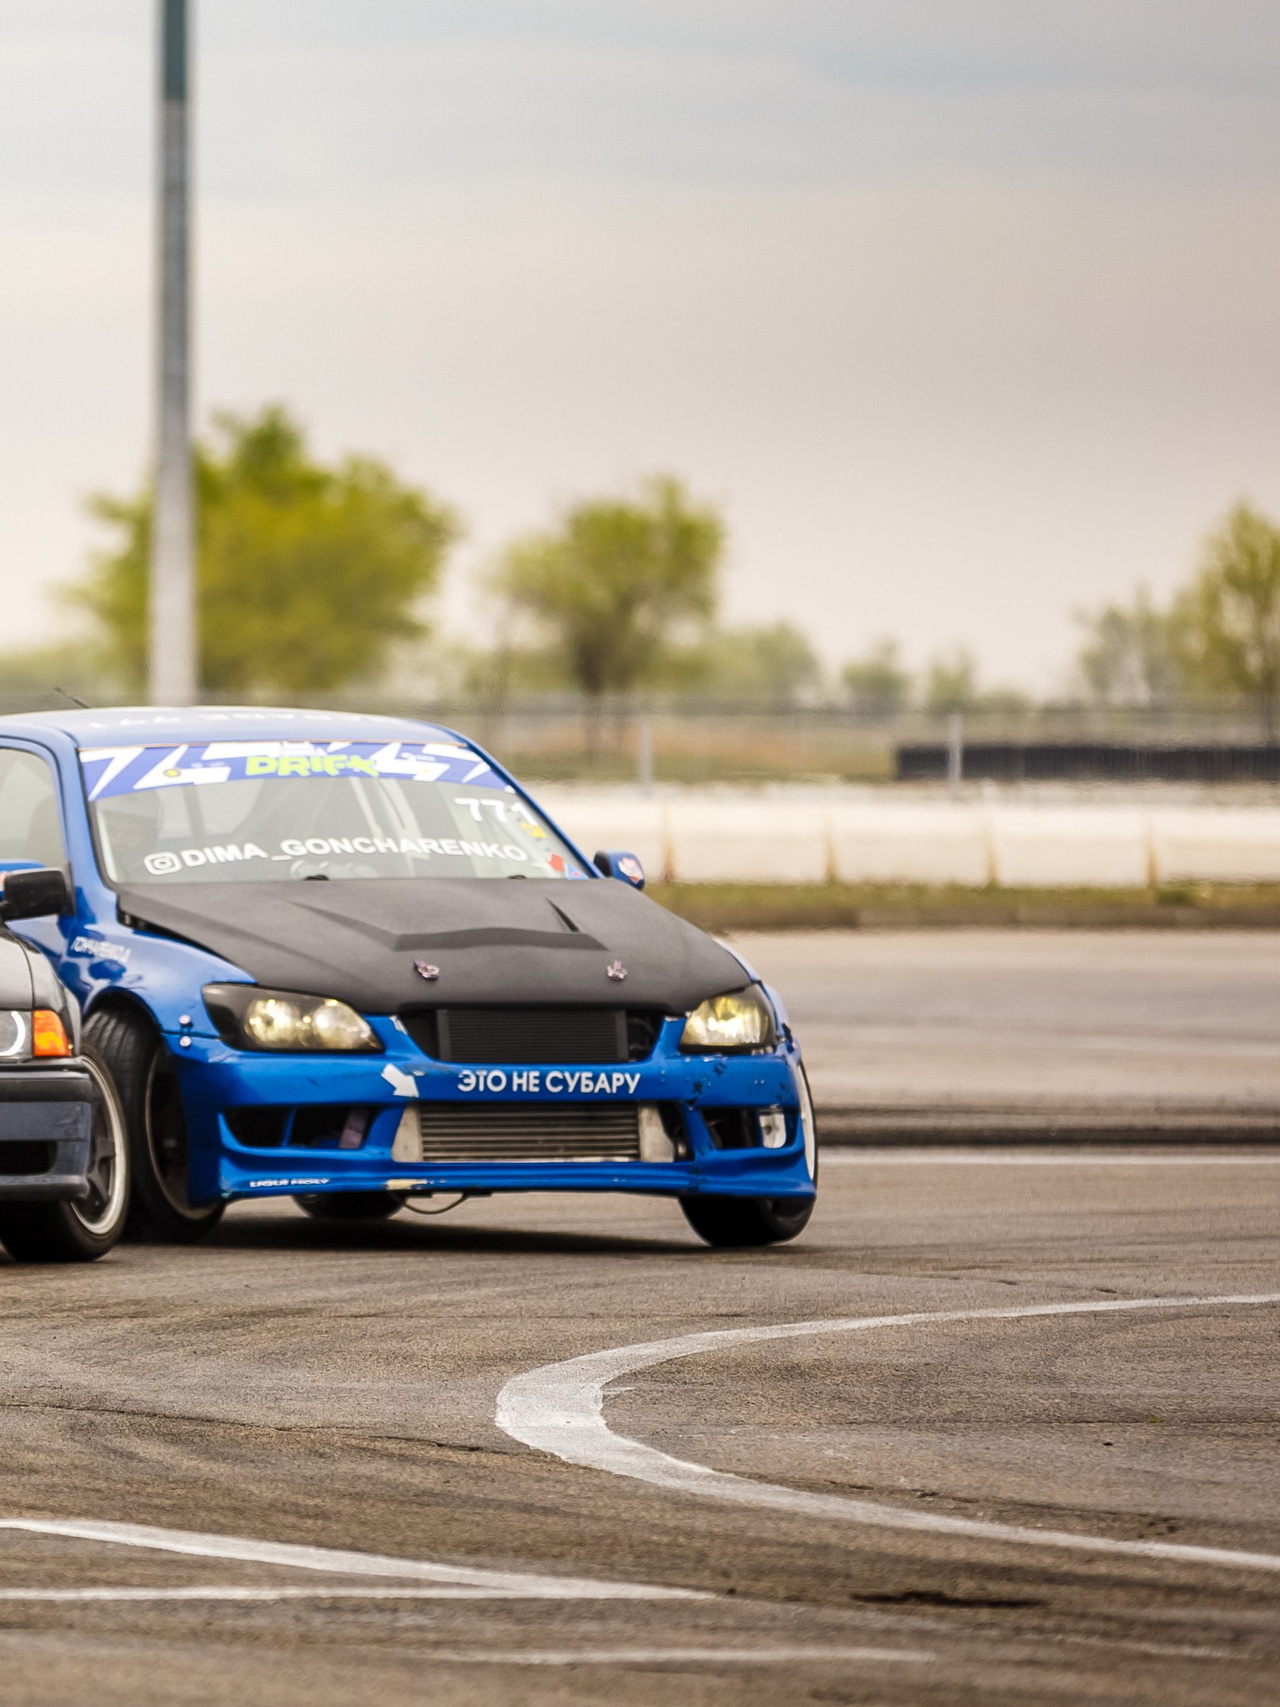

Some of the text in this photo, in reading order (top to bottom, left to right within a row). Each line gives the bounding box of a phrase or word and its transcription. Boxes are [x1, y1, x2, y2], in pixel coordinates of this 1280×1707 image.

[454, 797, 538, 826] 771
[457, 1070, 641, 1094] ЭТО НЕ СУБАРУ
